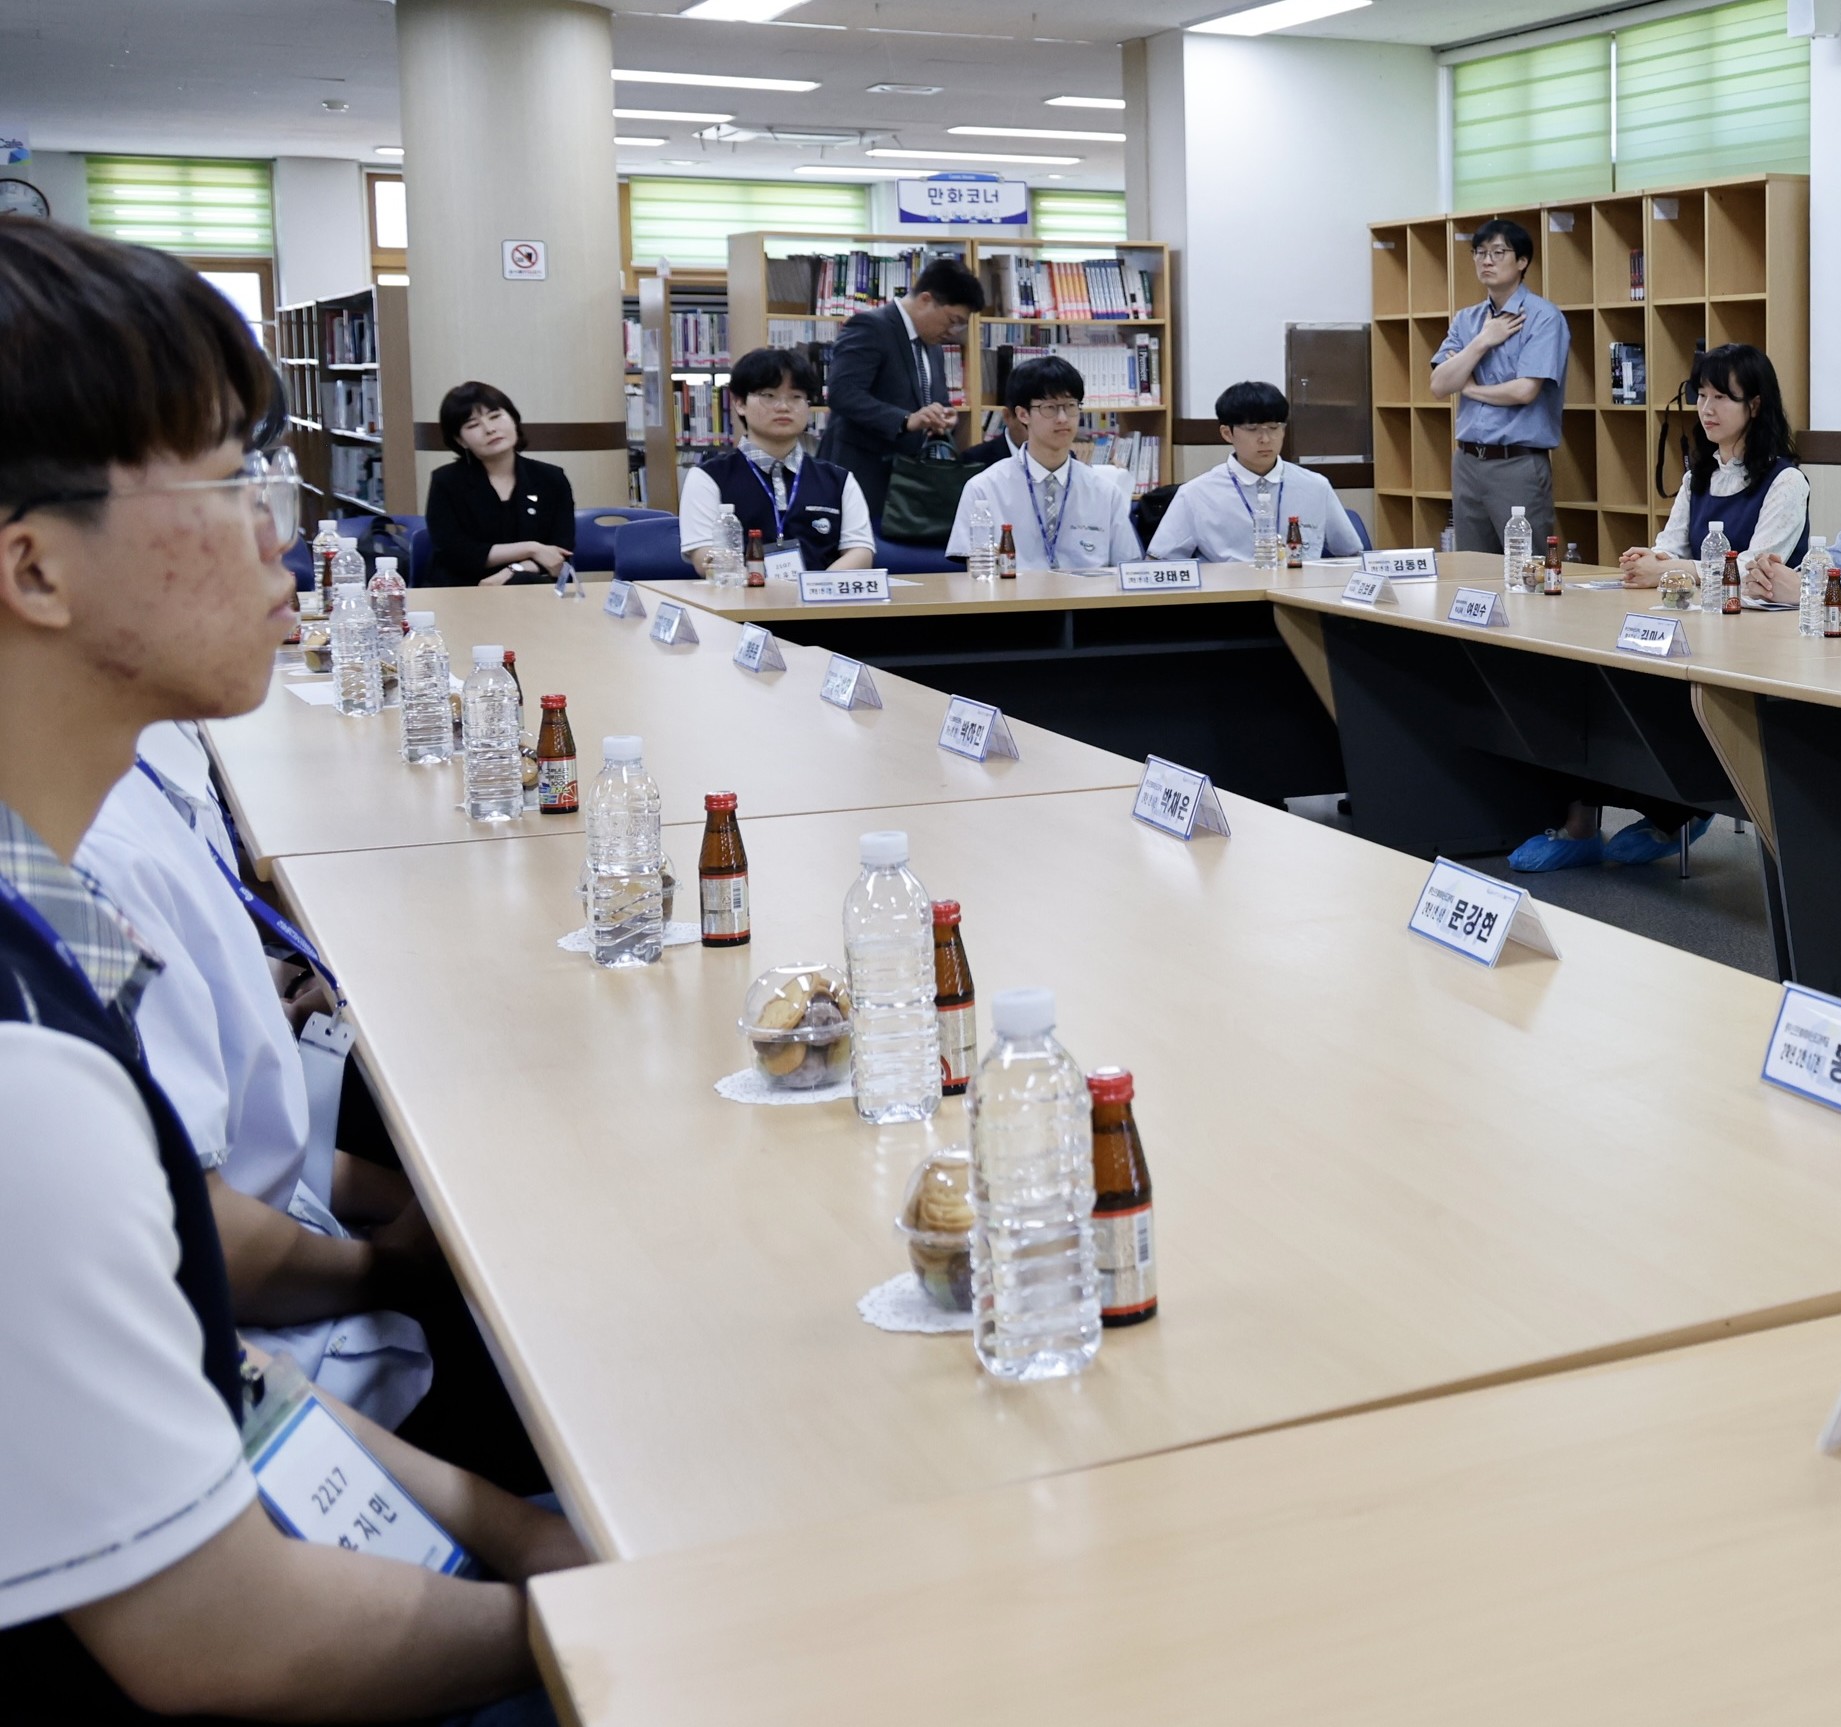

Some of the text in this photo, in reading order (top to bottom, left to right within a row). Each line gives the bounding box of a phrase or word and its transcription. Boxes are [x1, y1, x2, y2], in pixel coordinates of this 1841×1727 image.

[928, 187, 999, 206] 만화코너
[1393, 559, 1427, 572] 김동현
[1448, 899, 1498, 943] 문강현
[312, 1466, 348, 1515] 2217
